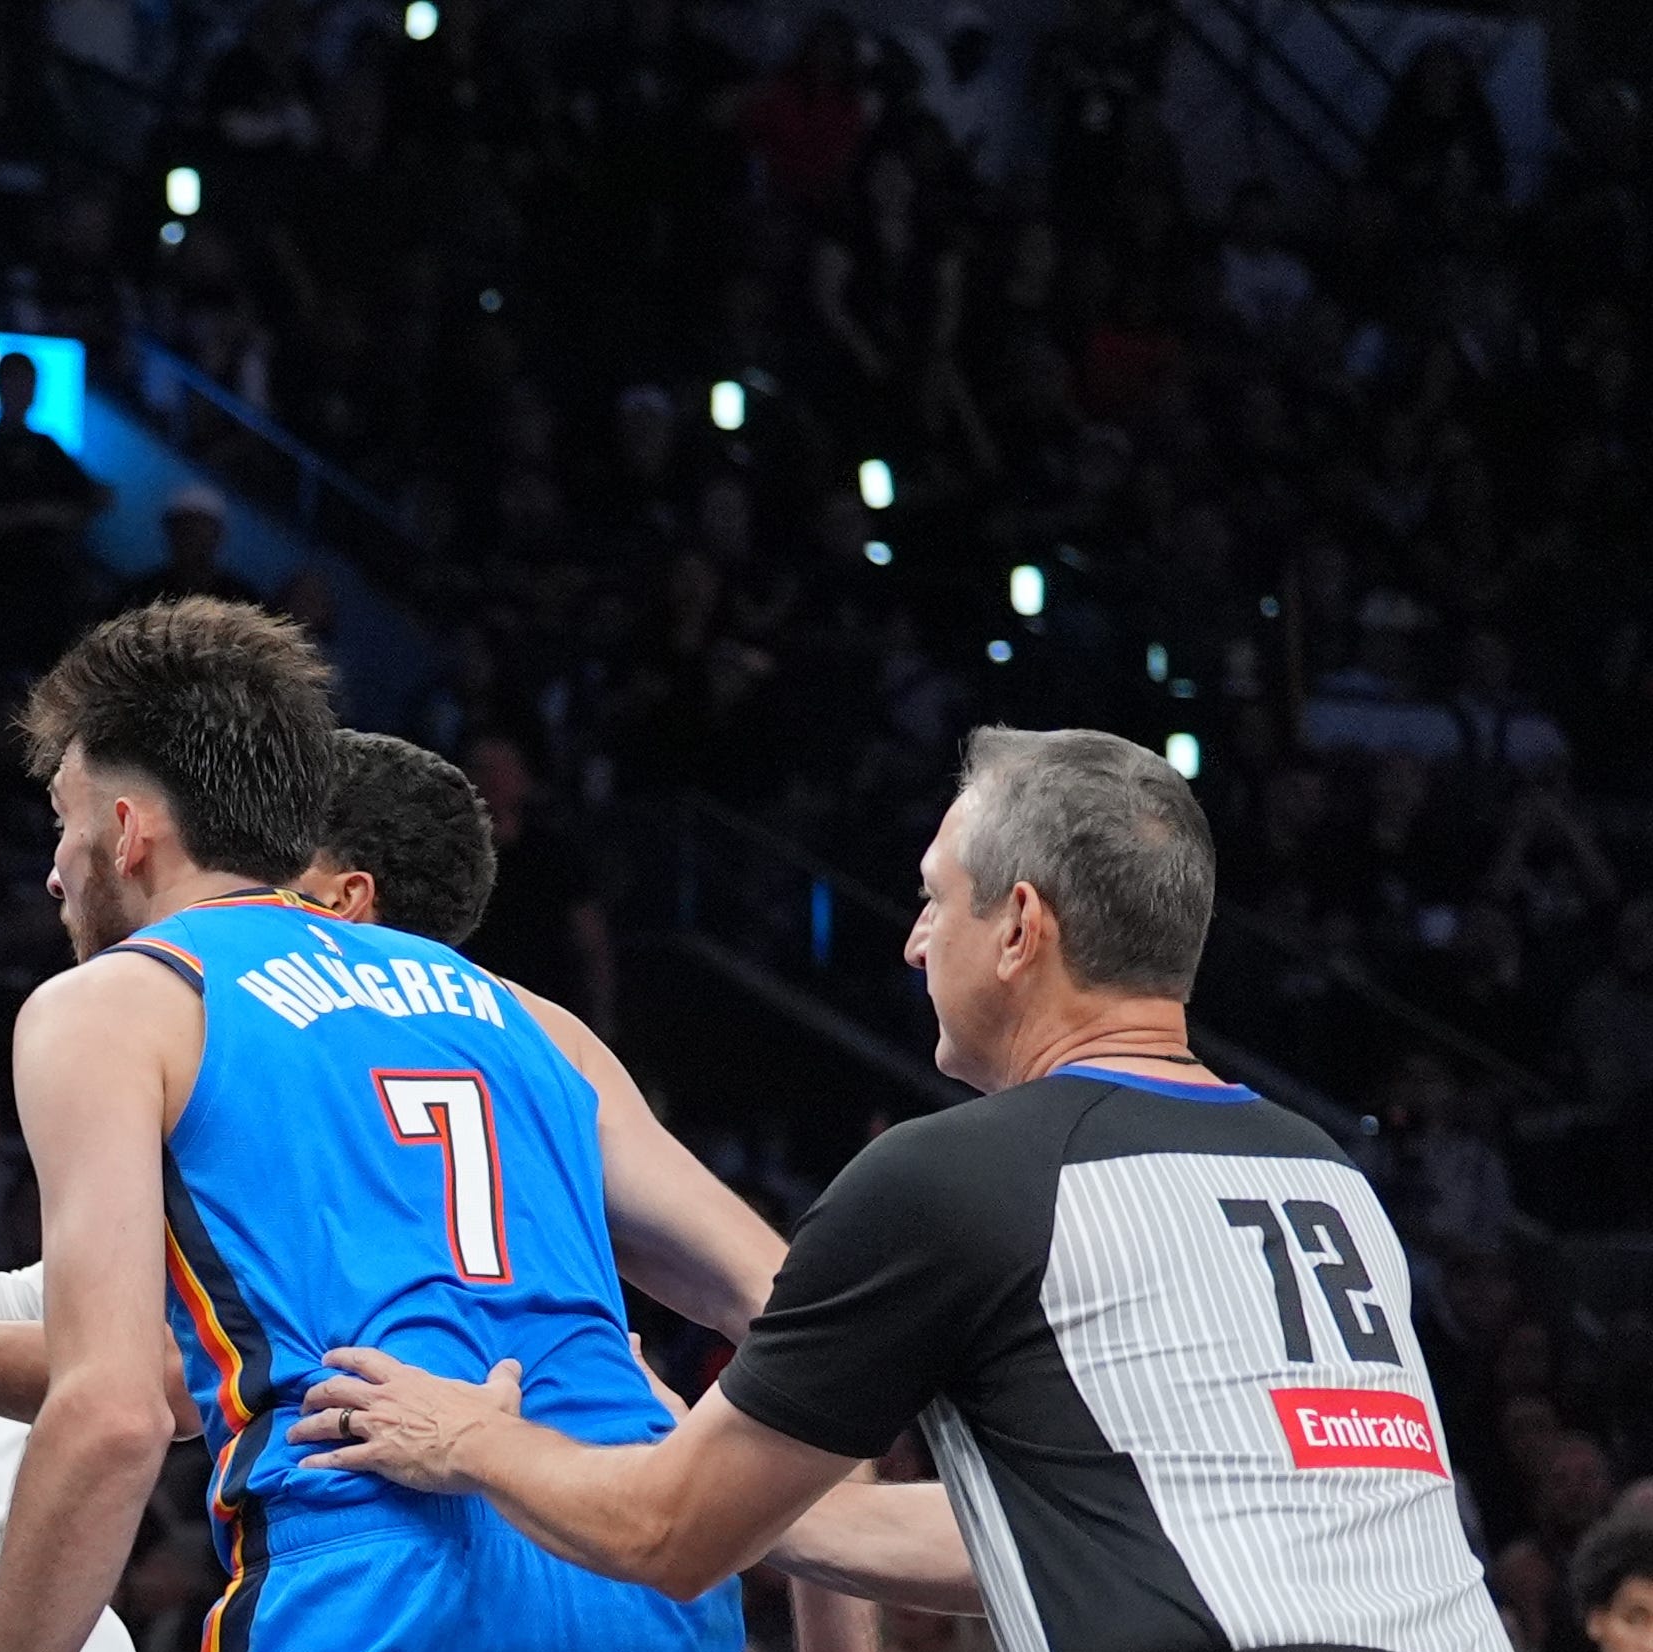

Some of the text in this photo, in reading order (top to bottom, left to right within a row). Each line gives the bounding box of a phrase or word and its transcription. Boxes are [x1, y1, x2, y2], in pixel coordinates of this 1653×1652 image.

[371, 1069, 513, 1285] 7
[1218, 1198, 1401, 1367] 72
[1296, 1408, 1432, 1454] Emirates
